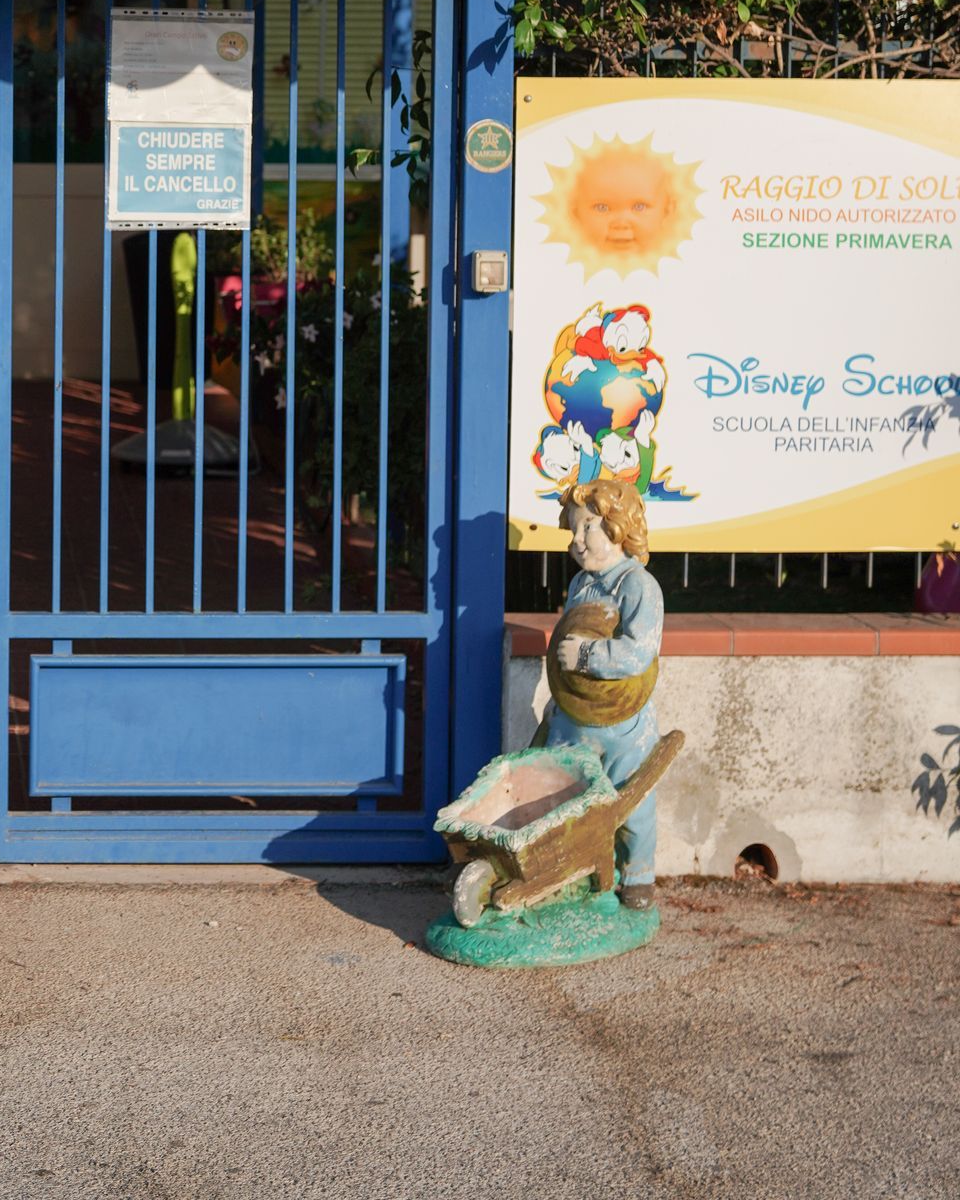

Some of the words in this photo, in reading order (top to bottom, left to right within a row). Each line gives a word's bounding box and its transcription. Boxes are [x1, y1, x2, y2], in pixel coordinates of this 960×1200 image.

[137, 132, 225, 149] CHIUDERE
[145, 154, 215, 171] SEMPRE
[124, 176, 140, 192] IL
[144, 176, 237, 193] CANCELLO
[720, 175, 842, 202] RAGGIO
[851, 175, 892, 200] DI
[196, 199, 239, 210] GRAZIE
[731, 208, 783, 223] ASILO
[789, 208, 832, 223] NIDO
[835, 208, 957, 224] AUTORIZZATO
[742, 232, 829, 249] SEZIONE
[836, 233, 953, 250] PRIMAVERA
[712, 416, 792, 432] SCUOLA
[797, 416, 936, 433] DELL'INFANZIA
[774, 437, 874, 452] PARITARIA
